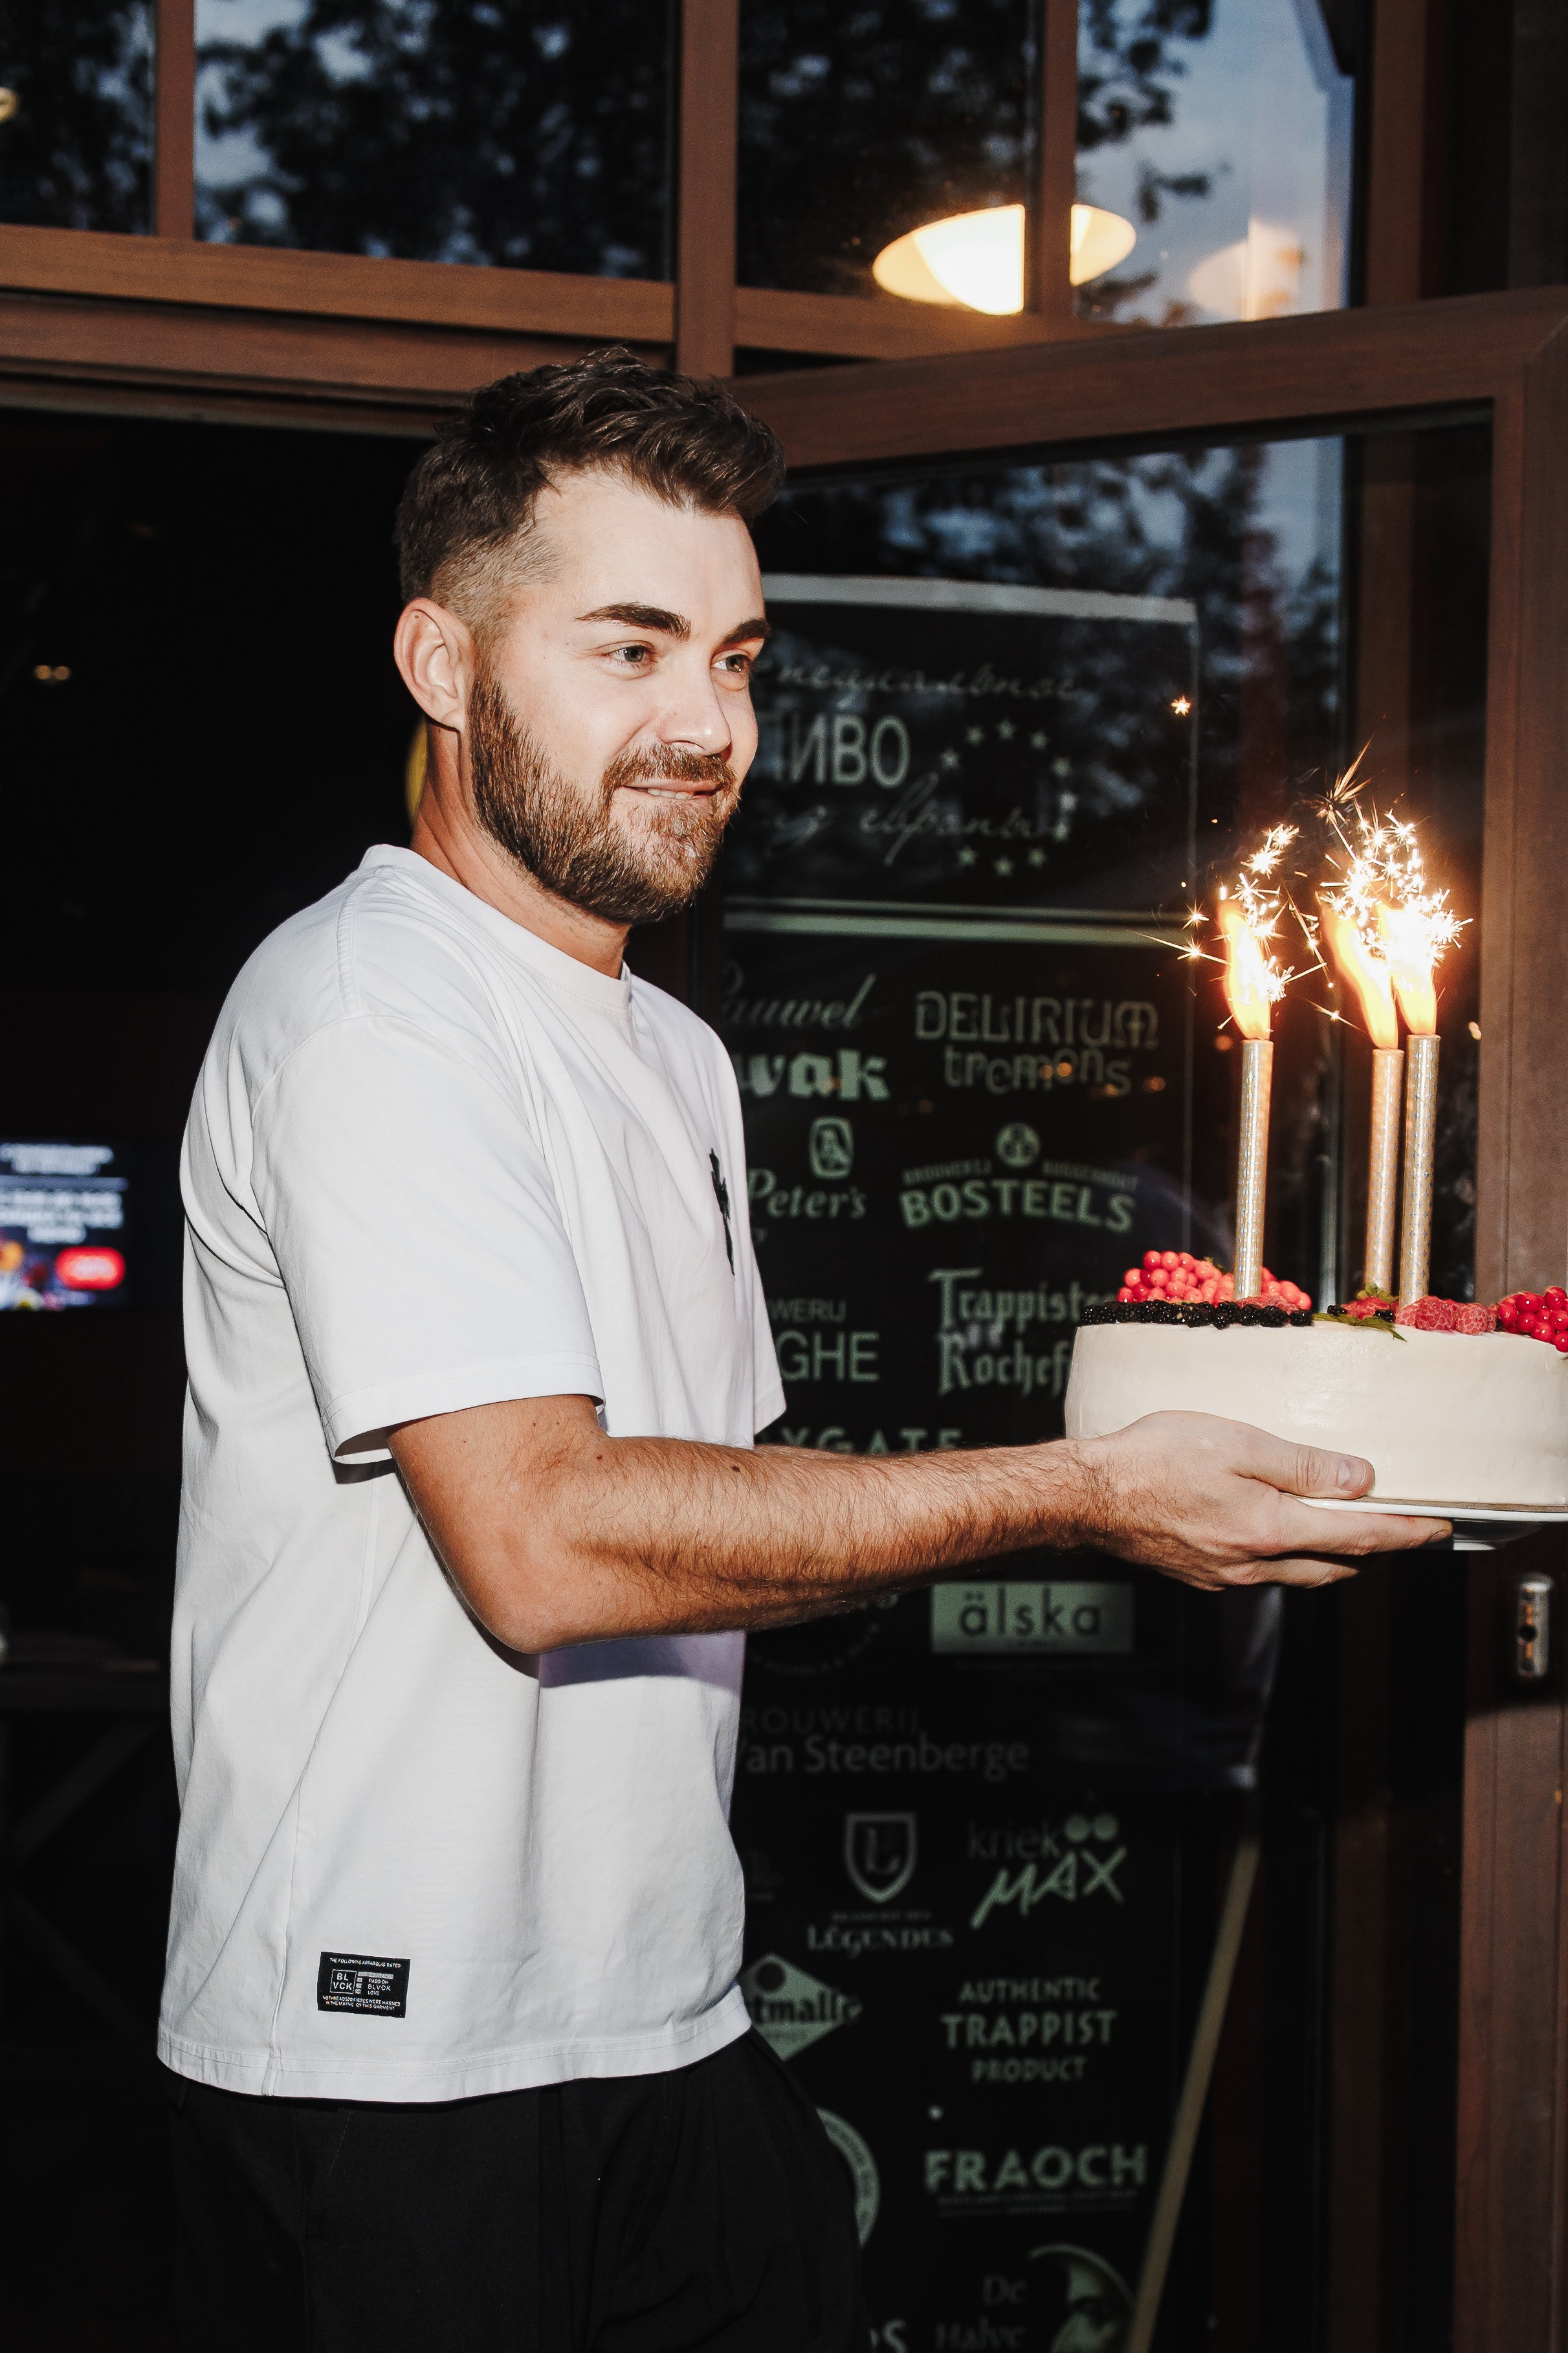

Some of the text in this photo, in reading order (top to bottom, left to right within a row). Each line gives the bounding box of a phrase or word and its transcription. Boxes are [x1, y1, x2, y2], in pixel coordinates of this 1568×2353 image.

[915, 989, 1160, 1050] DELIRIUM
[942, 1043, 1132, 1098] tremens
[899, 1178, 1136, 1234] BOSTEELS
[927, 1267, 1117, 1335] Trappist
[777, 1329, 881, 1383] GHE
[959, 1586, 1099, 1637] älska
[803, 1730, 1030, 1783] Steenberge
[967, 1818, 1062, 1860] kriek
[969, 1845, 1128, 1930] MAX
[333, 1981, 353, 1991] VCK
[337, 1972, 349, 1981] BL
[956, 1976, 1101, 2005] AUTHENTIC
[938, 2009, 1120, 2050] TRAPPIST
[971, 2055, 1088, 2084] PRODUCT
[923, 2143, 1149, 2194] FRAOCH
[982, 2273, 1028, 2306] De
[936, 2315, 1026, 2352] Halve
